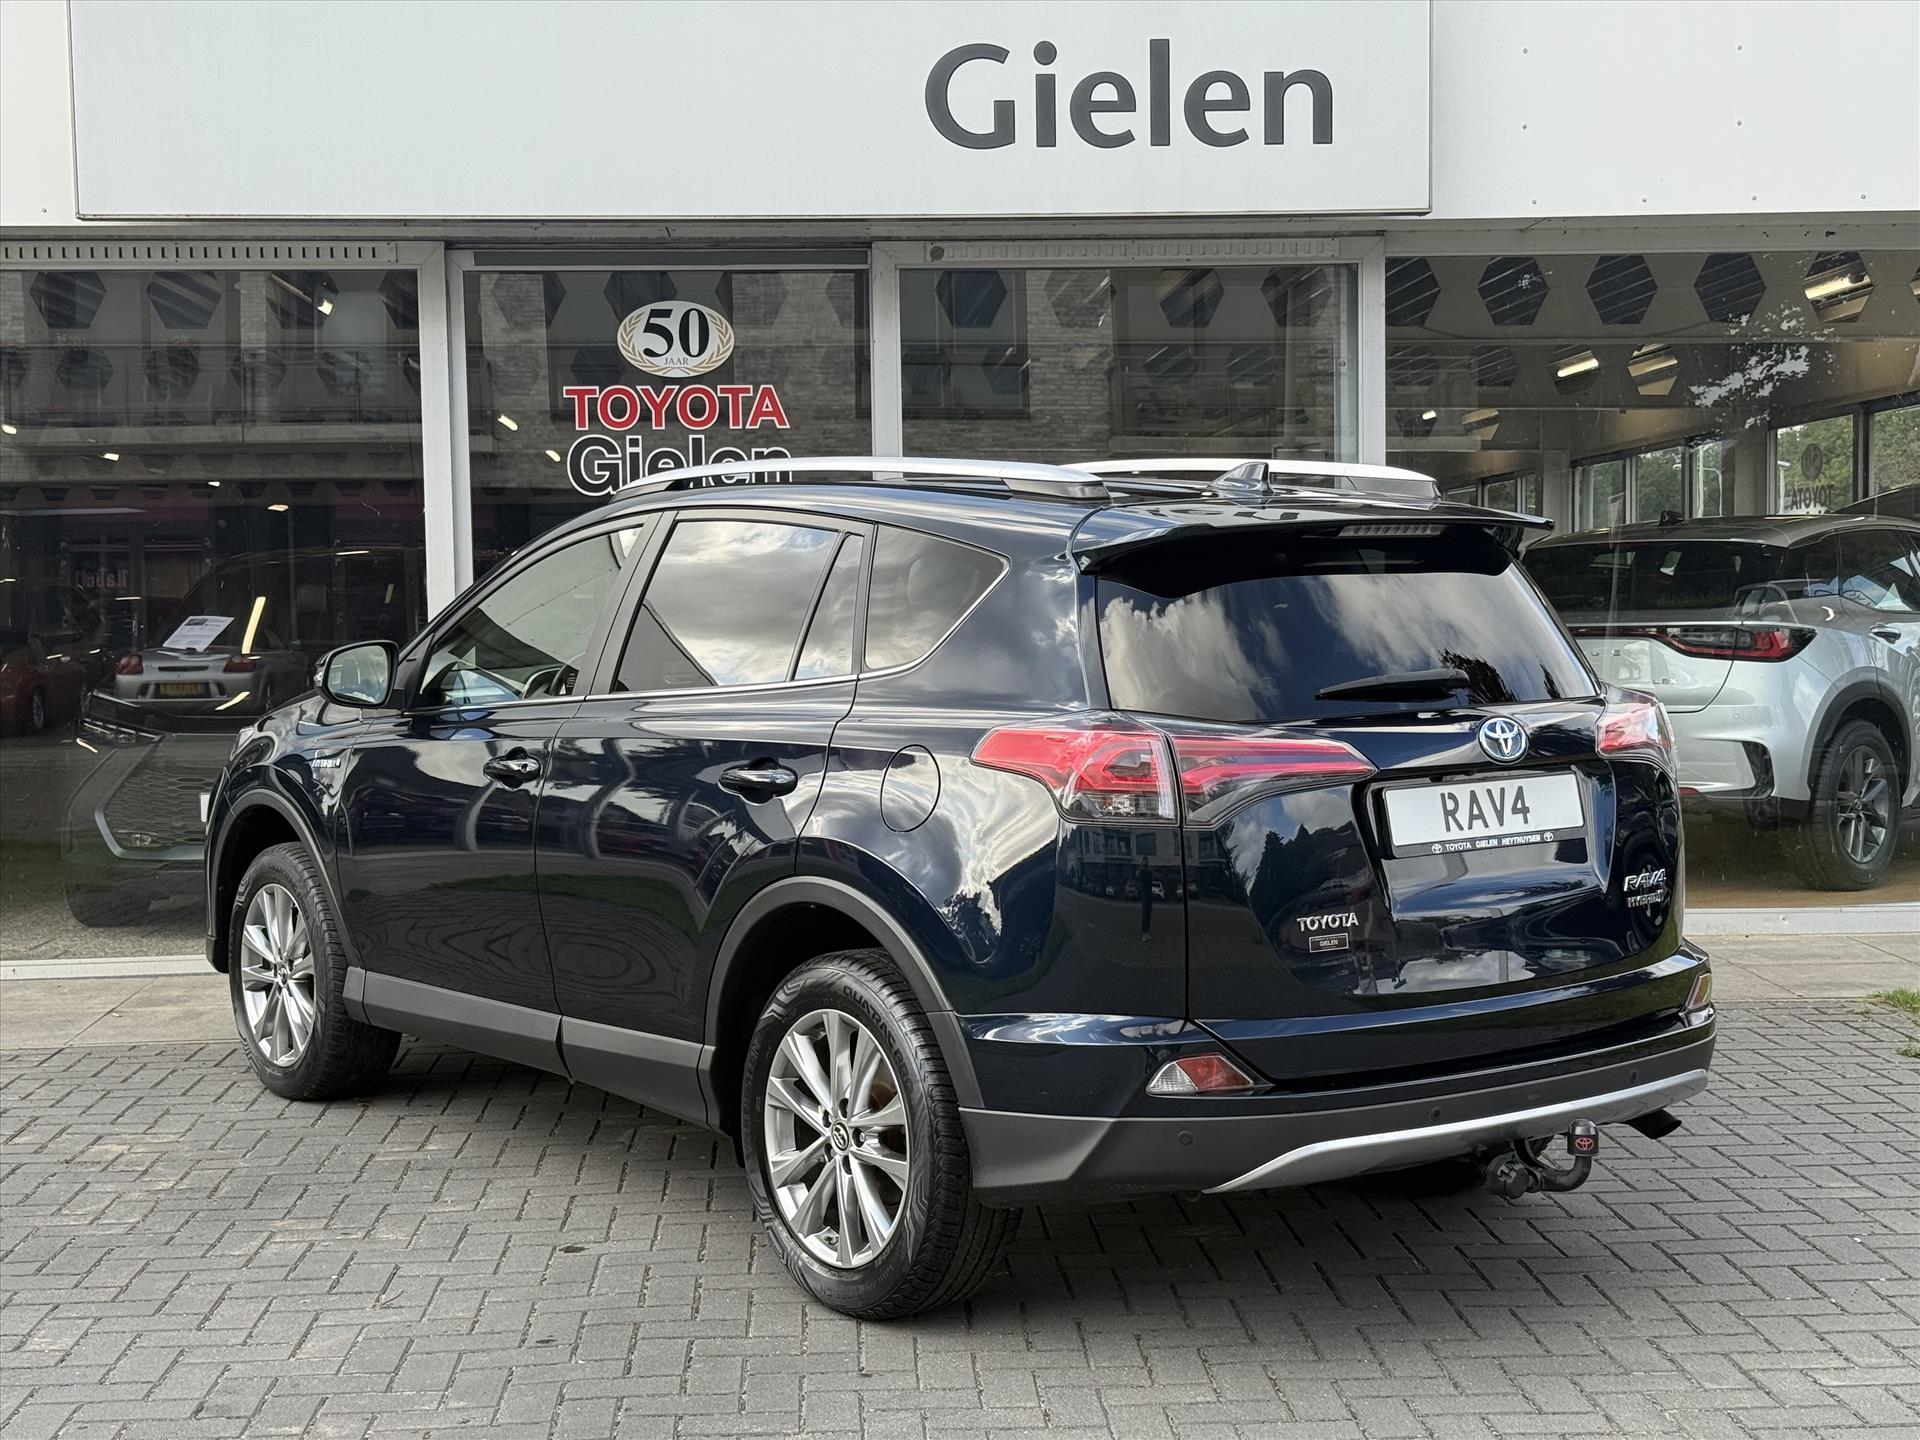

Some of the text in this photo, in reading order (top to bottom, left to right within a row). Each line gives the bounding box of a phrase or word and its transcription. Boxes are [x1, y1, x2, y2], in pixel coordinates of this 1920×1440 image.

[925, 39, 1333, 149] Gielen
[643, 308, 709, 357] 50
[664, 357, 689, 365] JAAR
[563, 385, 790, 430] TOYOTA
[1440, 785, 1530, 832] RAV4
[1445, 842, 1472, 852] TOYOTA
[1624, 868, 1667, 892] RAV4
[1297, 913, 1359, 932] TOYOTA
[843, 986, 896, 1047] QUATRAC
